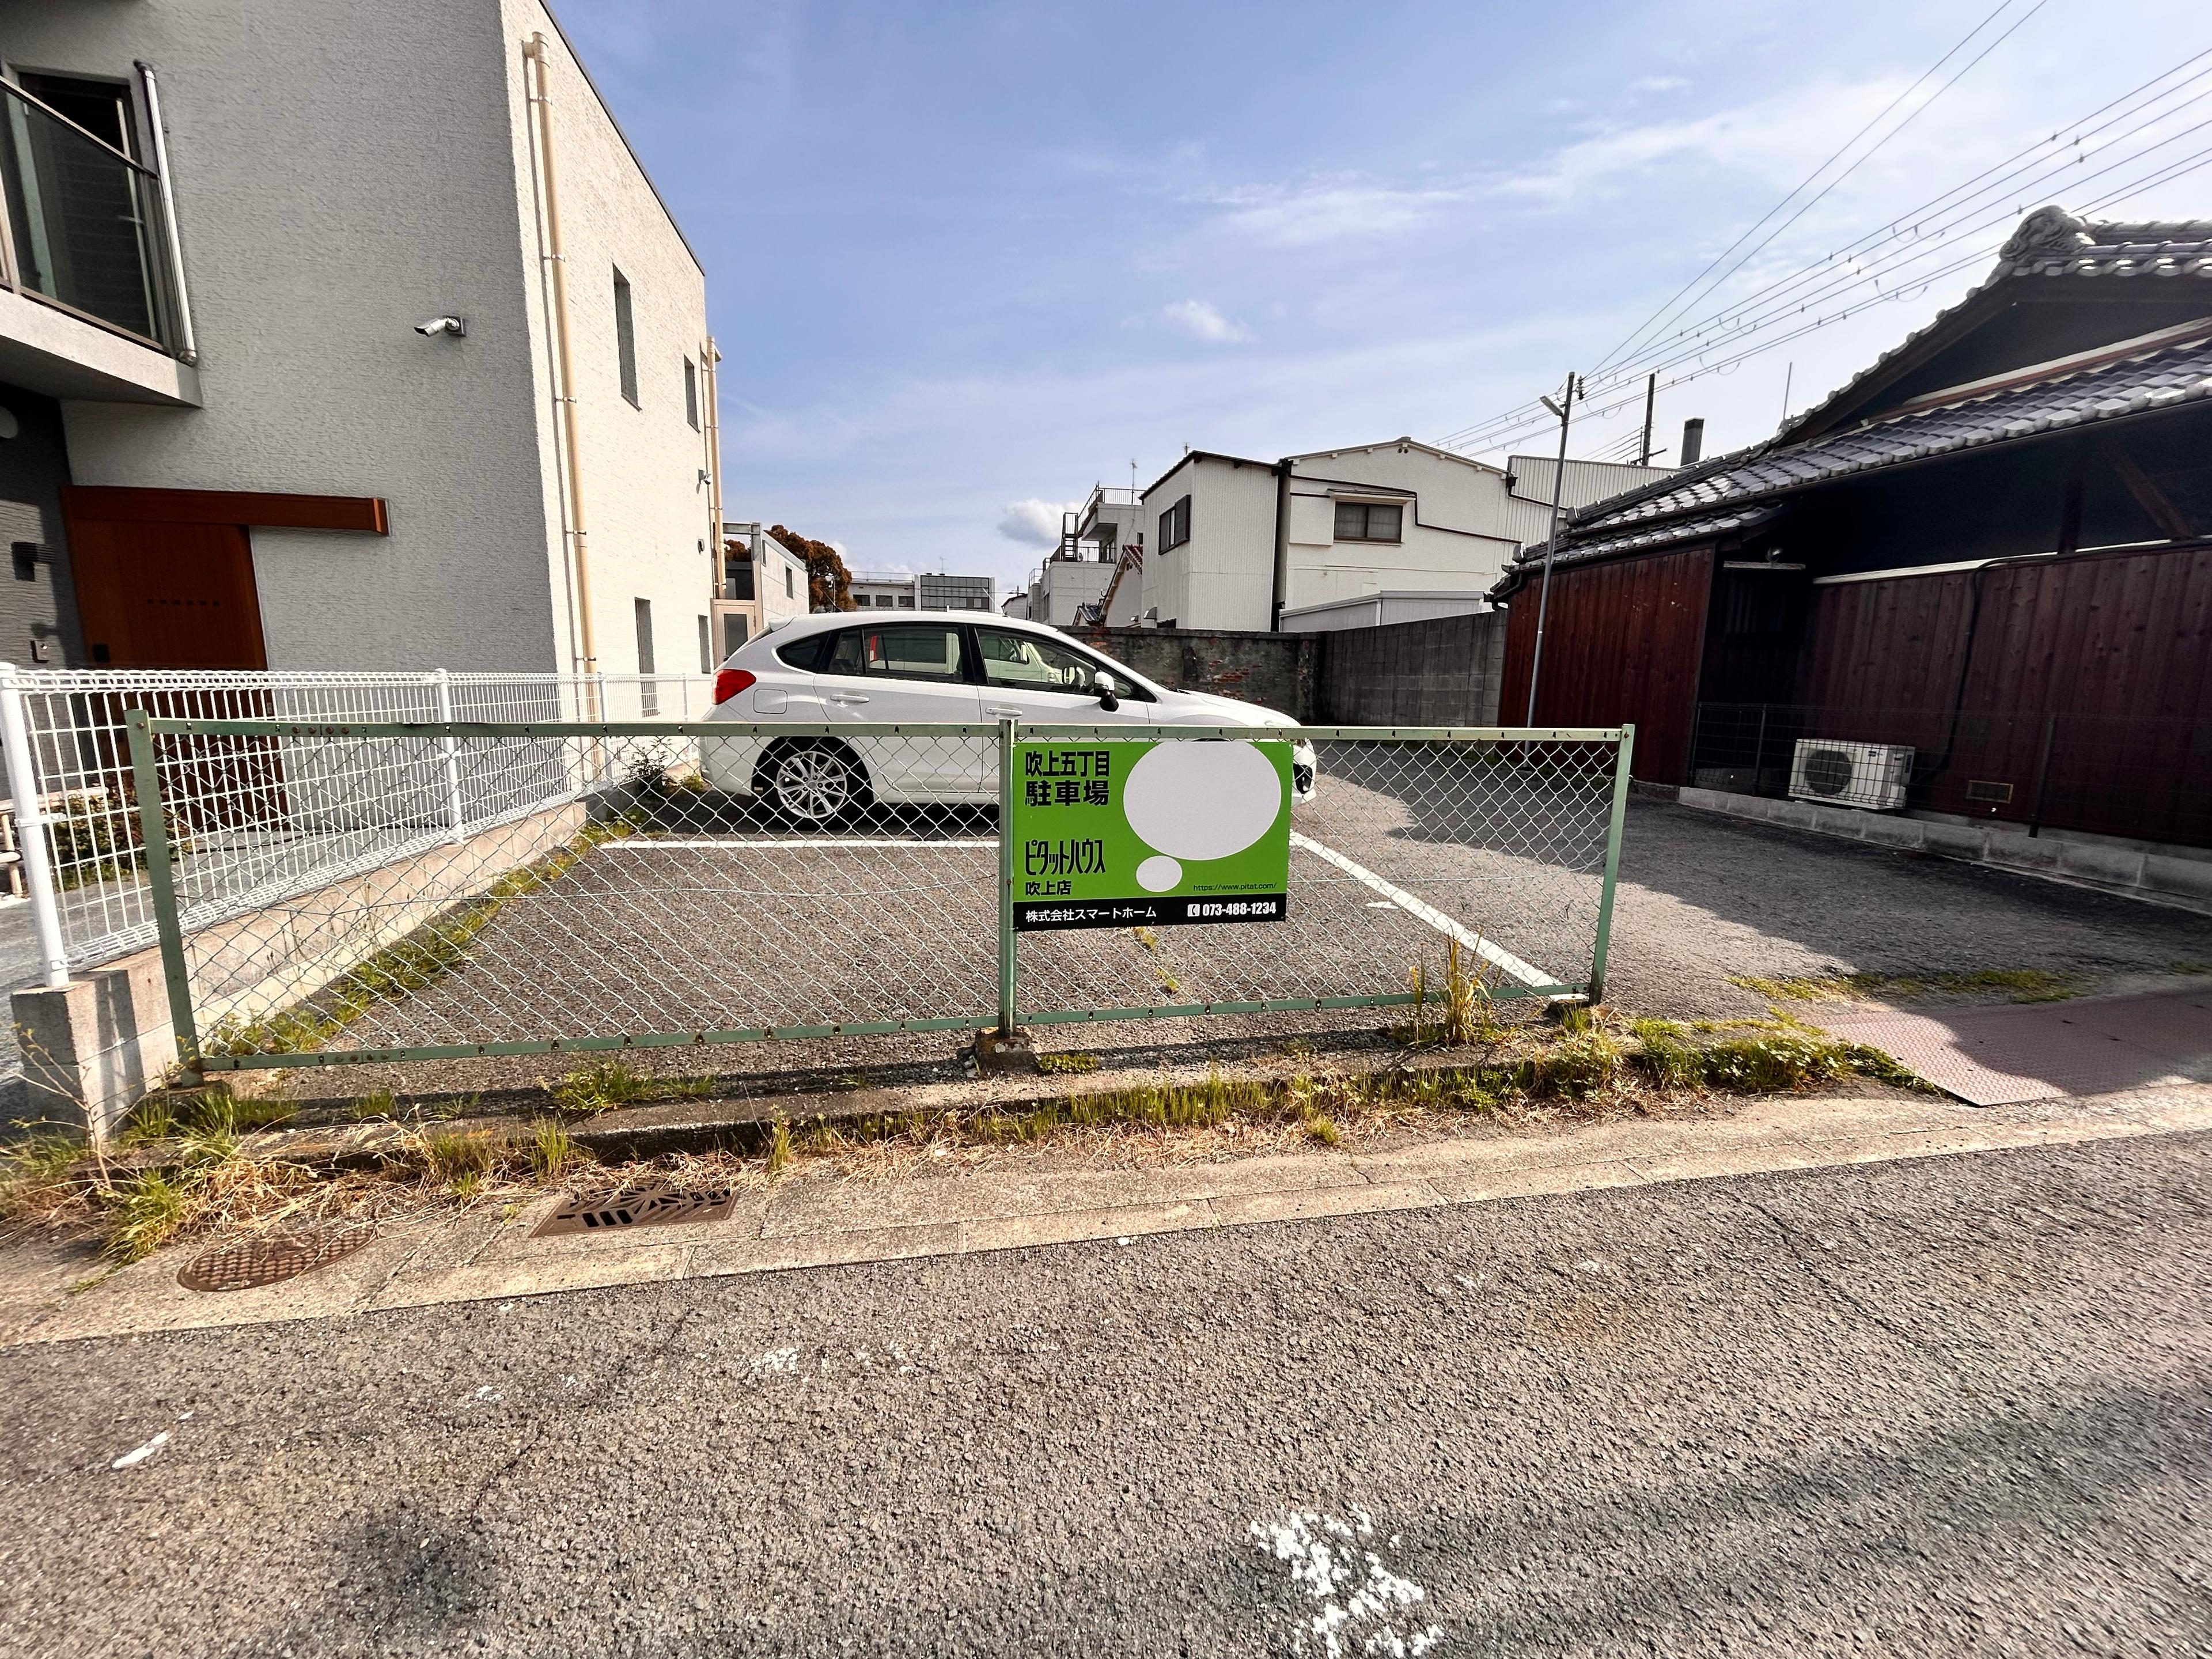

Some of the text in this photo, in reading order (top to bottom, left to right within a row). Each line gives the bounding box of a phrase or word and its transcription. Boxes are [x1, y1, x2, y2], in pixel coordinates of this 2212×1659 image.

[1025, 750, 1110, 778] 吹上五丁目
[1024, 779, 1109, 807] 駐車場
[1025, 838, 1107, 876] ピタットハウス
[1025, 880, 1072, 896] 吹上店
[1193, 882, 1277, 892] https://www.pitat.com/
[1025, 906, 1157, 923] 株式会社スマートホーム
[1202, 902, 1277, 916] 073-488-1234
